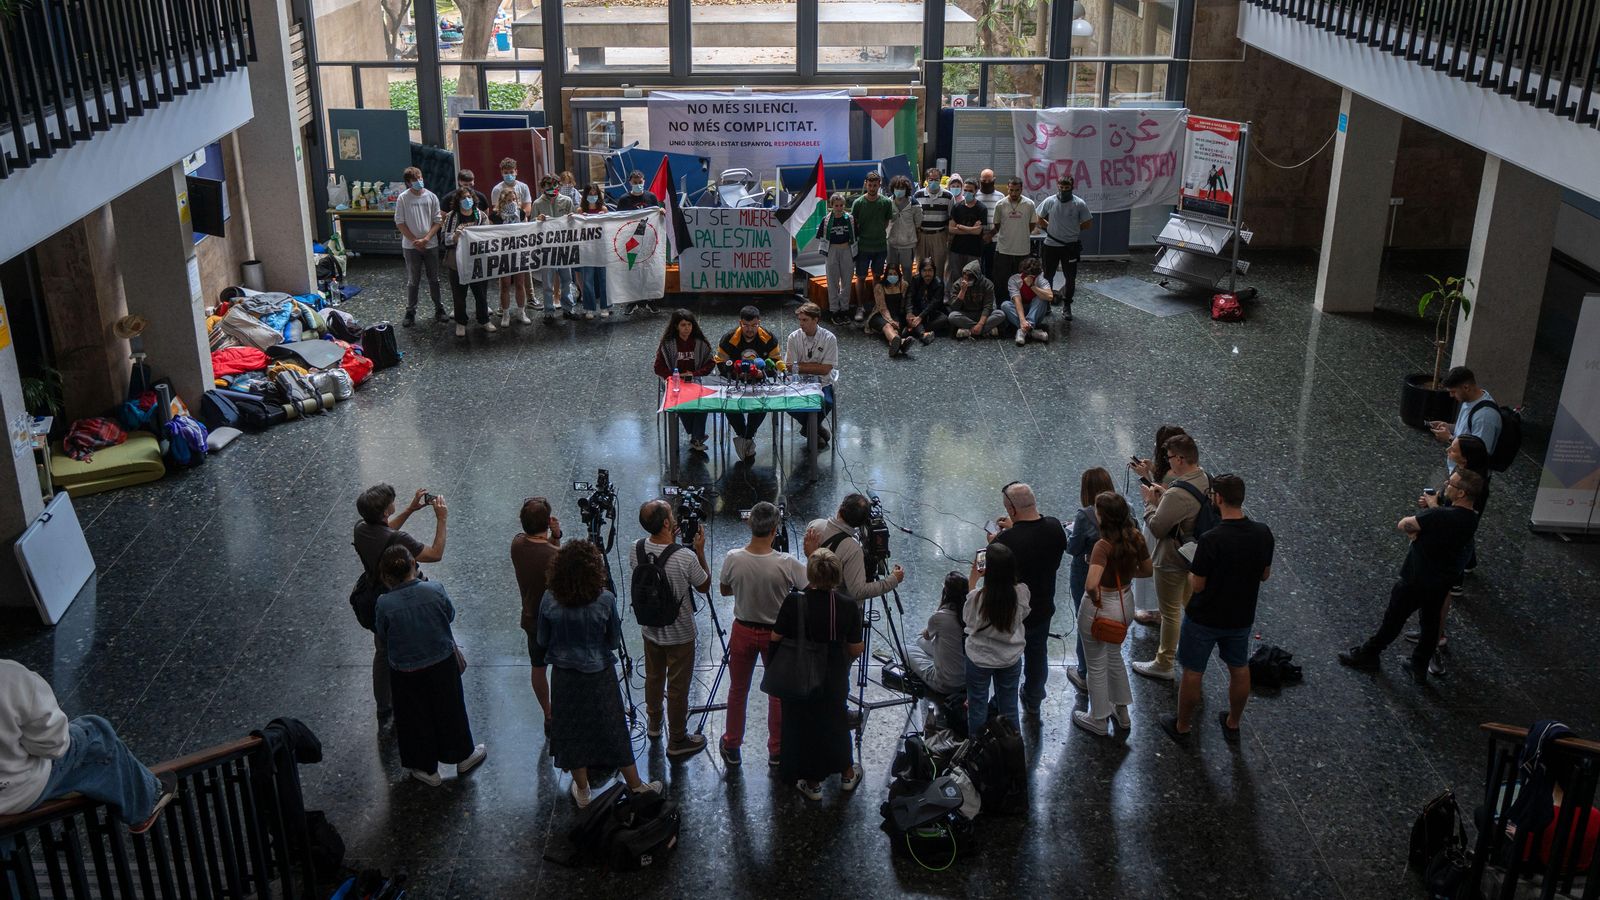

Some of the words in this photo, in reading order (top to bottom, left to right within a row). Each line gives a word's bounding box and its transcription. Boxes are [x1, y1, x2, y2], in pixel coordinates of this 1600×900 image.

[687, 103, 708, 114] NO
[712, 101, 739, 114] MÉS
[743, 102, 798, 114] SILENCI.
[669, 121, 689, 132] NO
[693, 119, 720, 132] MÉS
[724, 120, 817, 132] COMPLICITAT.
[1109, 111, 1161, 154] غزة
[1023, 158, 1092, 192] GAZA
[684, 209, 699, 226] SI
[709, 209, 729, 226] SE
[739, 209, 777, 227] MUERE
[470, 240, 499, 256] DELS
[501, 232, 544, 252] PAÏSOS
[546, 226, 602, 245] CATALANS
[695, 228, 771, 249] PALESTINA
[471, 258, 483, 279] A
[487, 244, 580, 278] PALESTINA
[700, 251, 721, 269] SE
[733, 252, 772, 269] MUERE
[691, 271, 709, 289] LA
[715, 270, 779, 289] HUMANIDAD
